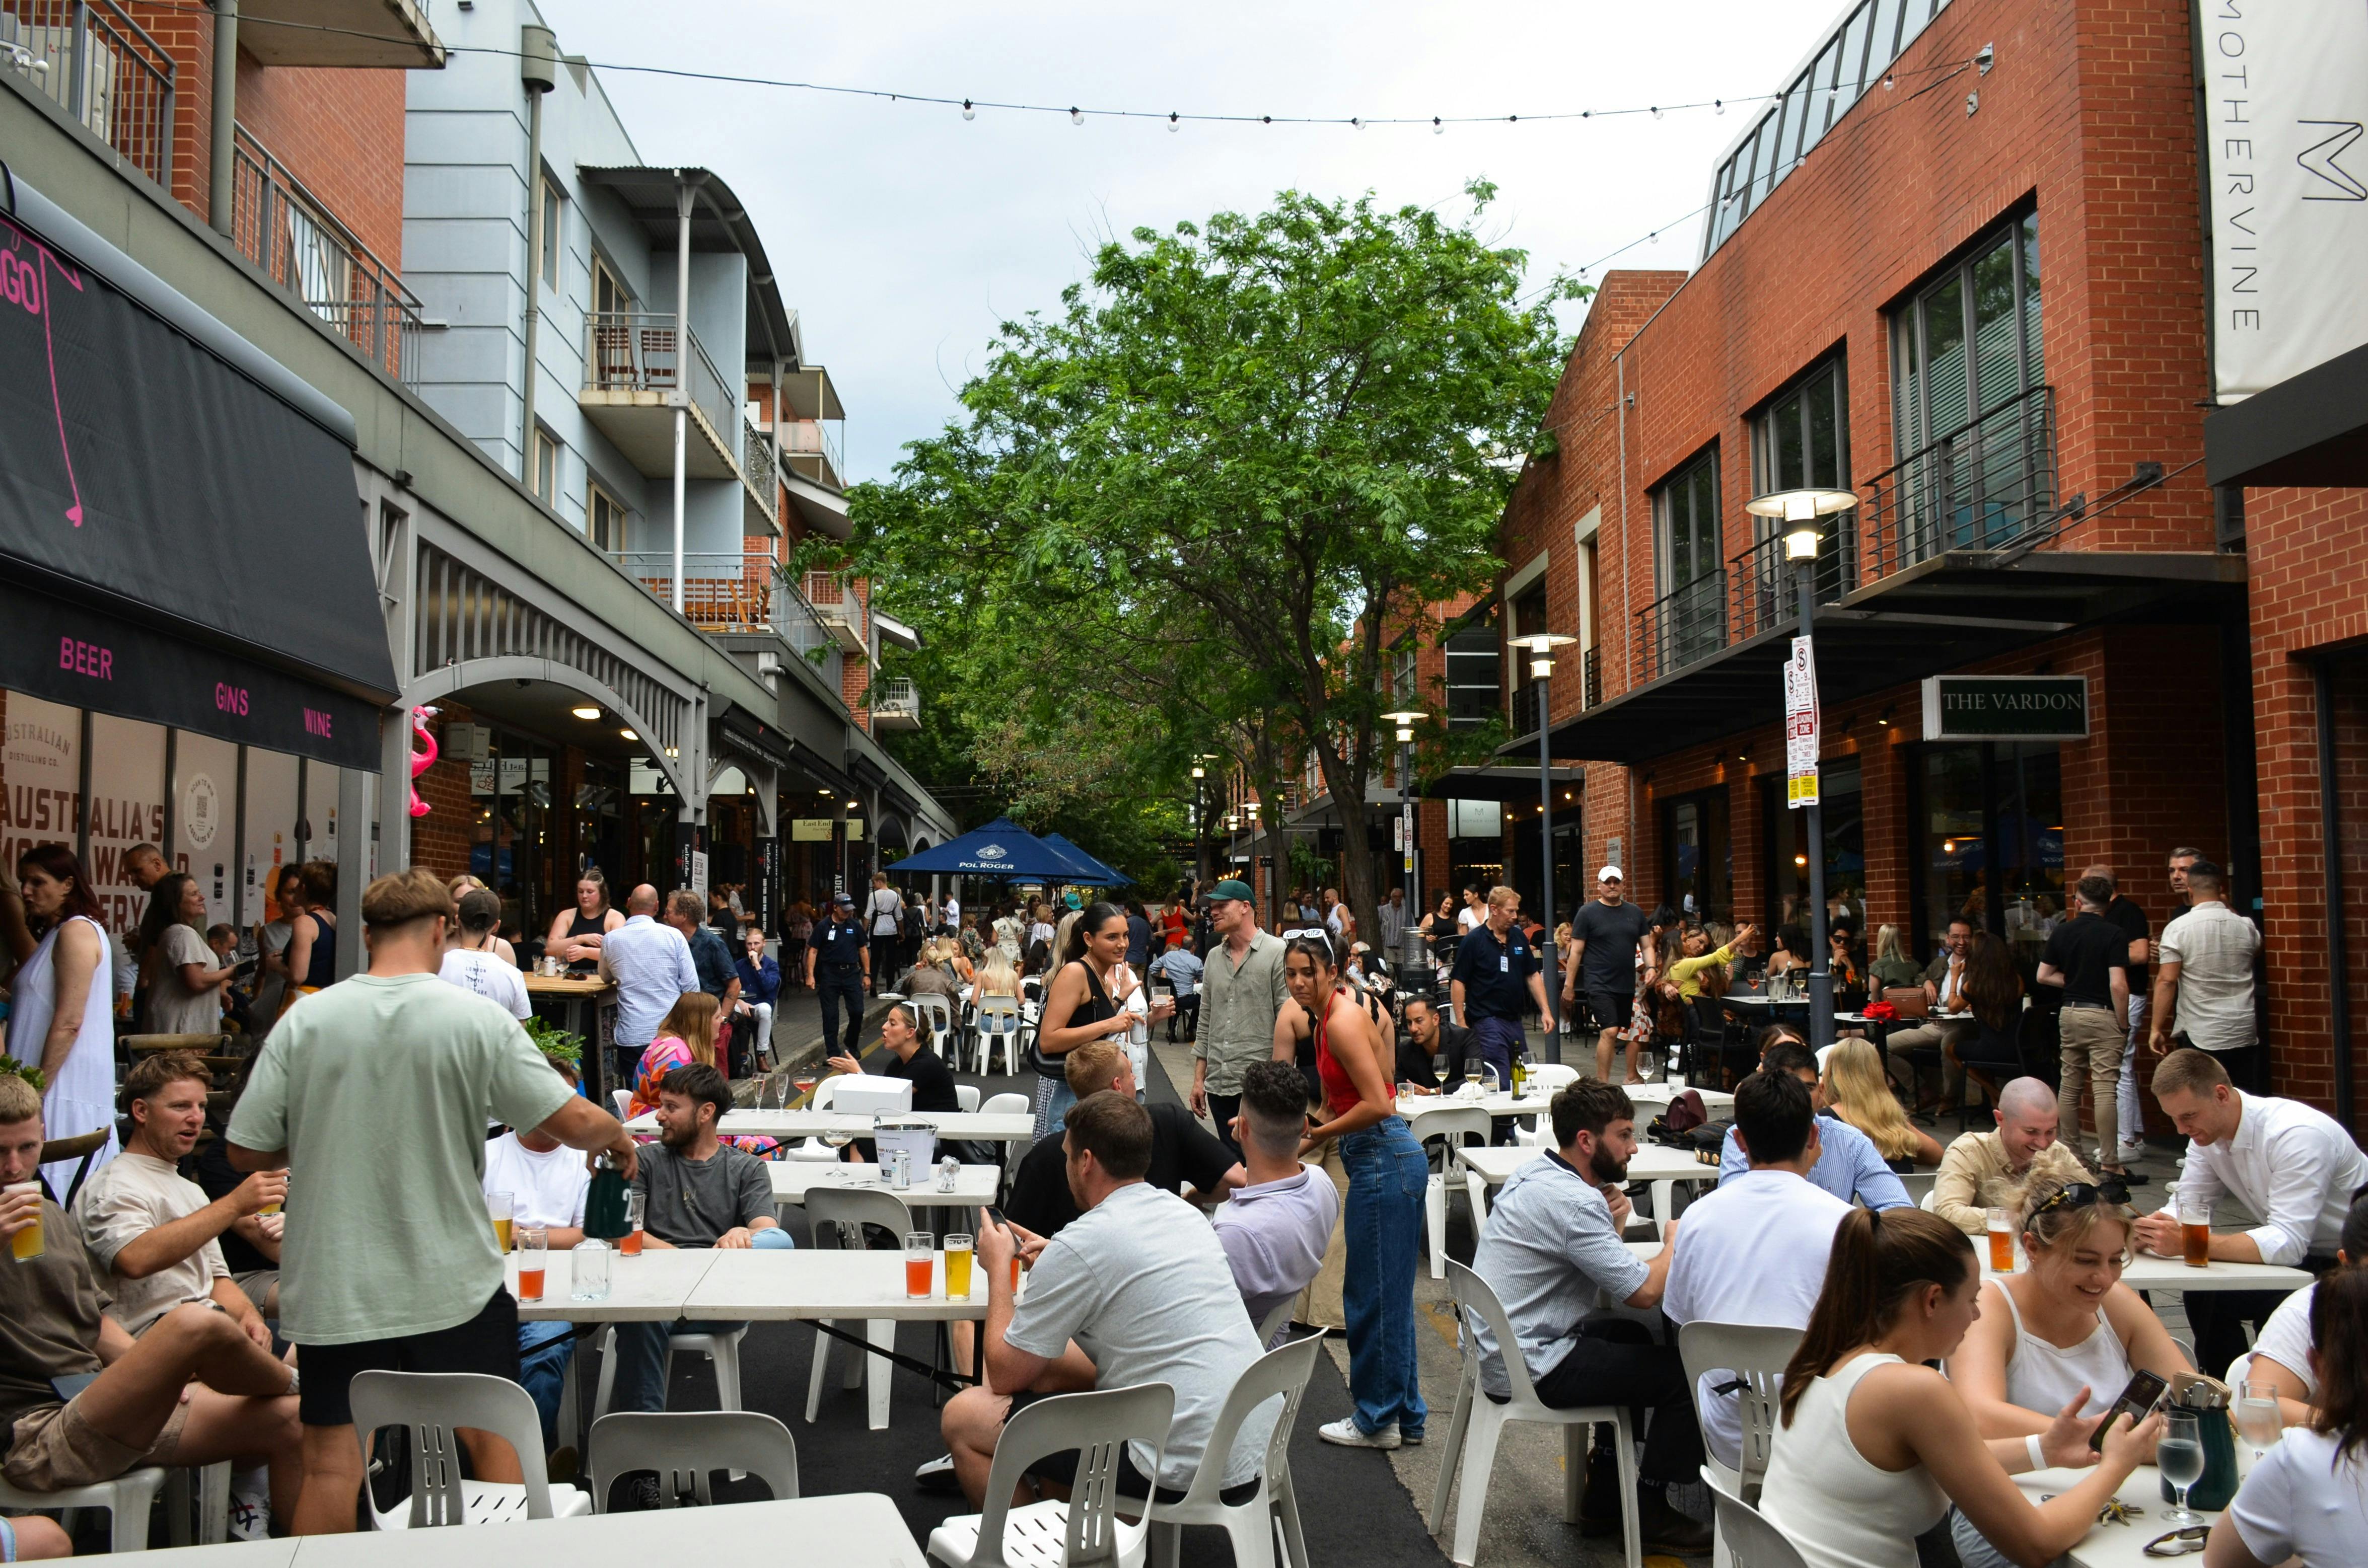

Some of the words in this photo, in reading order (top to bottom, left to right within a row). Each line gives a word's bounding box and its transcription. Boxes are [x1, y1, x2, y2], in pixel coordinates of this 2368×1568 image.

[0, 248, 40, 315] GO
[59, 636, 112, 681] BEER
[215, 682, 249, 717] GINS
[1943, 693, 1986, 710] THE
[1991, 693, 2082, 710] VARDON
[304, 707, 332, 738] WINE
[6, 724, 71, 756] USTRALIAN
[9, 752, 46, 765] DISTILLING
[834, 874, 842, 897] ADEL
